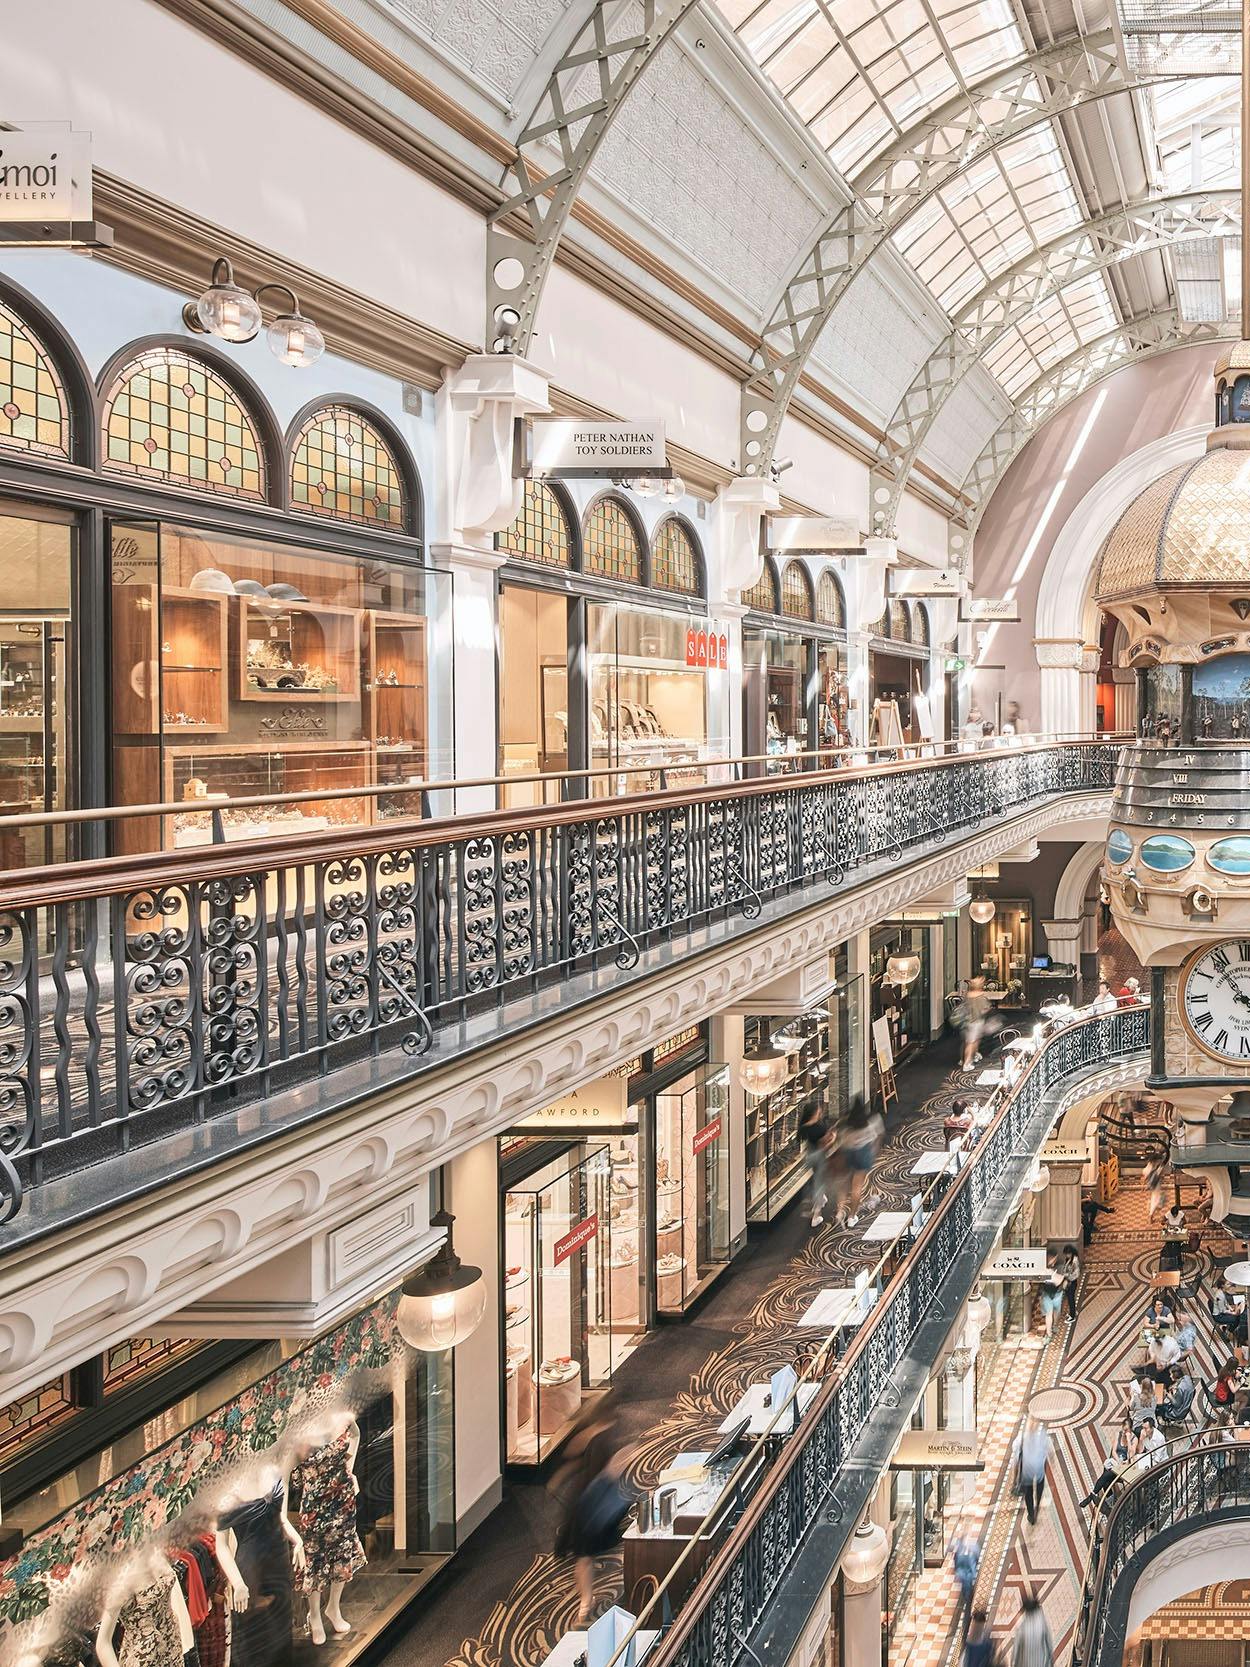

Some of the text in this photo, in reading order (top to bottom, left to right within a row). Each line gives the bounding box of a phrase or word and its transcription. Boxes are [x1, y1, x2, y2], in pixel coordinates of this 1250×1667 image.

[0, 149, 57, 187] moi
[0, 192, 56, 200] ELLERY
[573, 433, 654, 443] PETER NATHAN
[575, 446, 652, 456] TOY SOLDIERS
[688, 641, 726, 661] SALE
[1172, 793, 1208, 804] FRIDAY
[1147, 811, 1154, 821] 3
[1170, 813, 1177, 823] 4
[1198, 813, 1205, 824] 5
[1227, 814, 1235, 824] 6
[1238, 944, 1250, 962] XII
[557, 1221, 595, 1257] Dominique's
